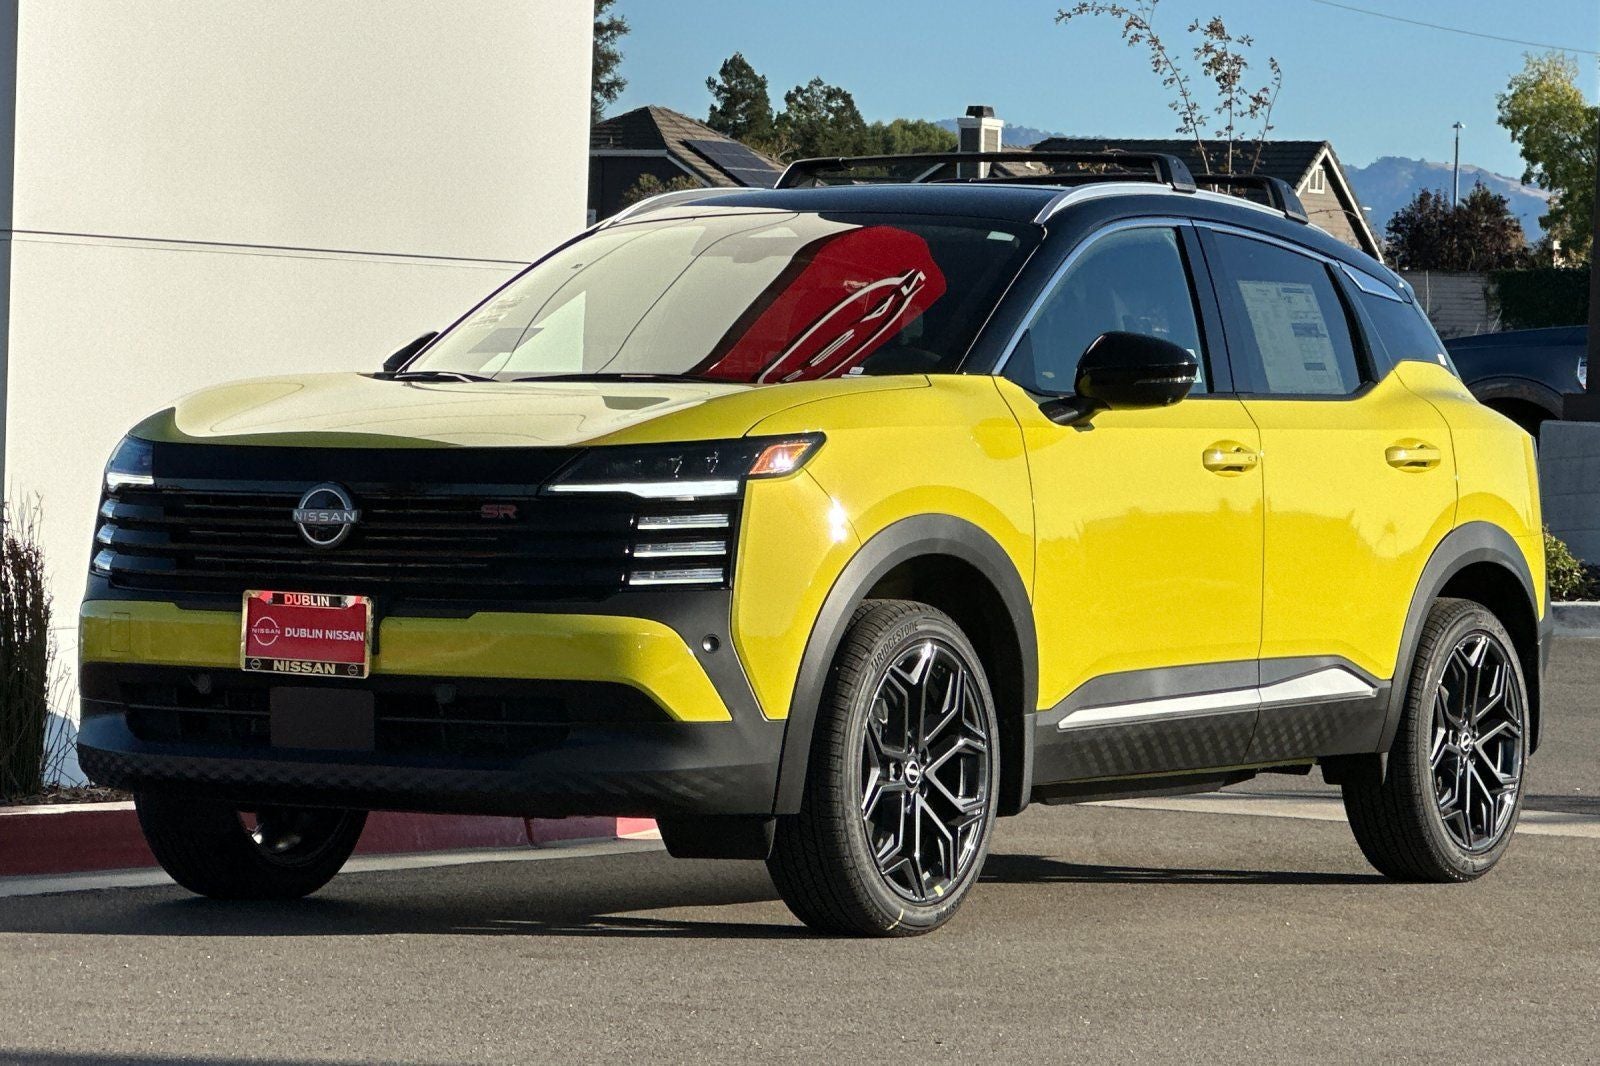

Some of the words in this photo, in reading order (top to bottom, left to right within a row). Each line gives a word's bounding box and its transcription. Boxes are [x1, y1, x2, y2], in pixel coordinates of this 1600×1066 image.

[293, 510, 356, 522] NISSAN
[481, 504, 518, 519] SR
[284, 593, 330, 607] DUBLIN
[285, 627, 323, 638] DUBLIN
[326, 630, 364, 641] NISSAN
[273, 659, 336, 675] NISSAN
